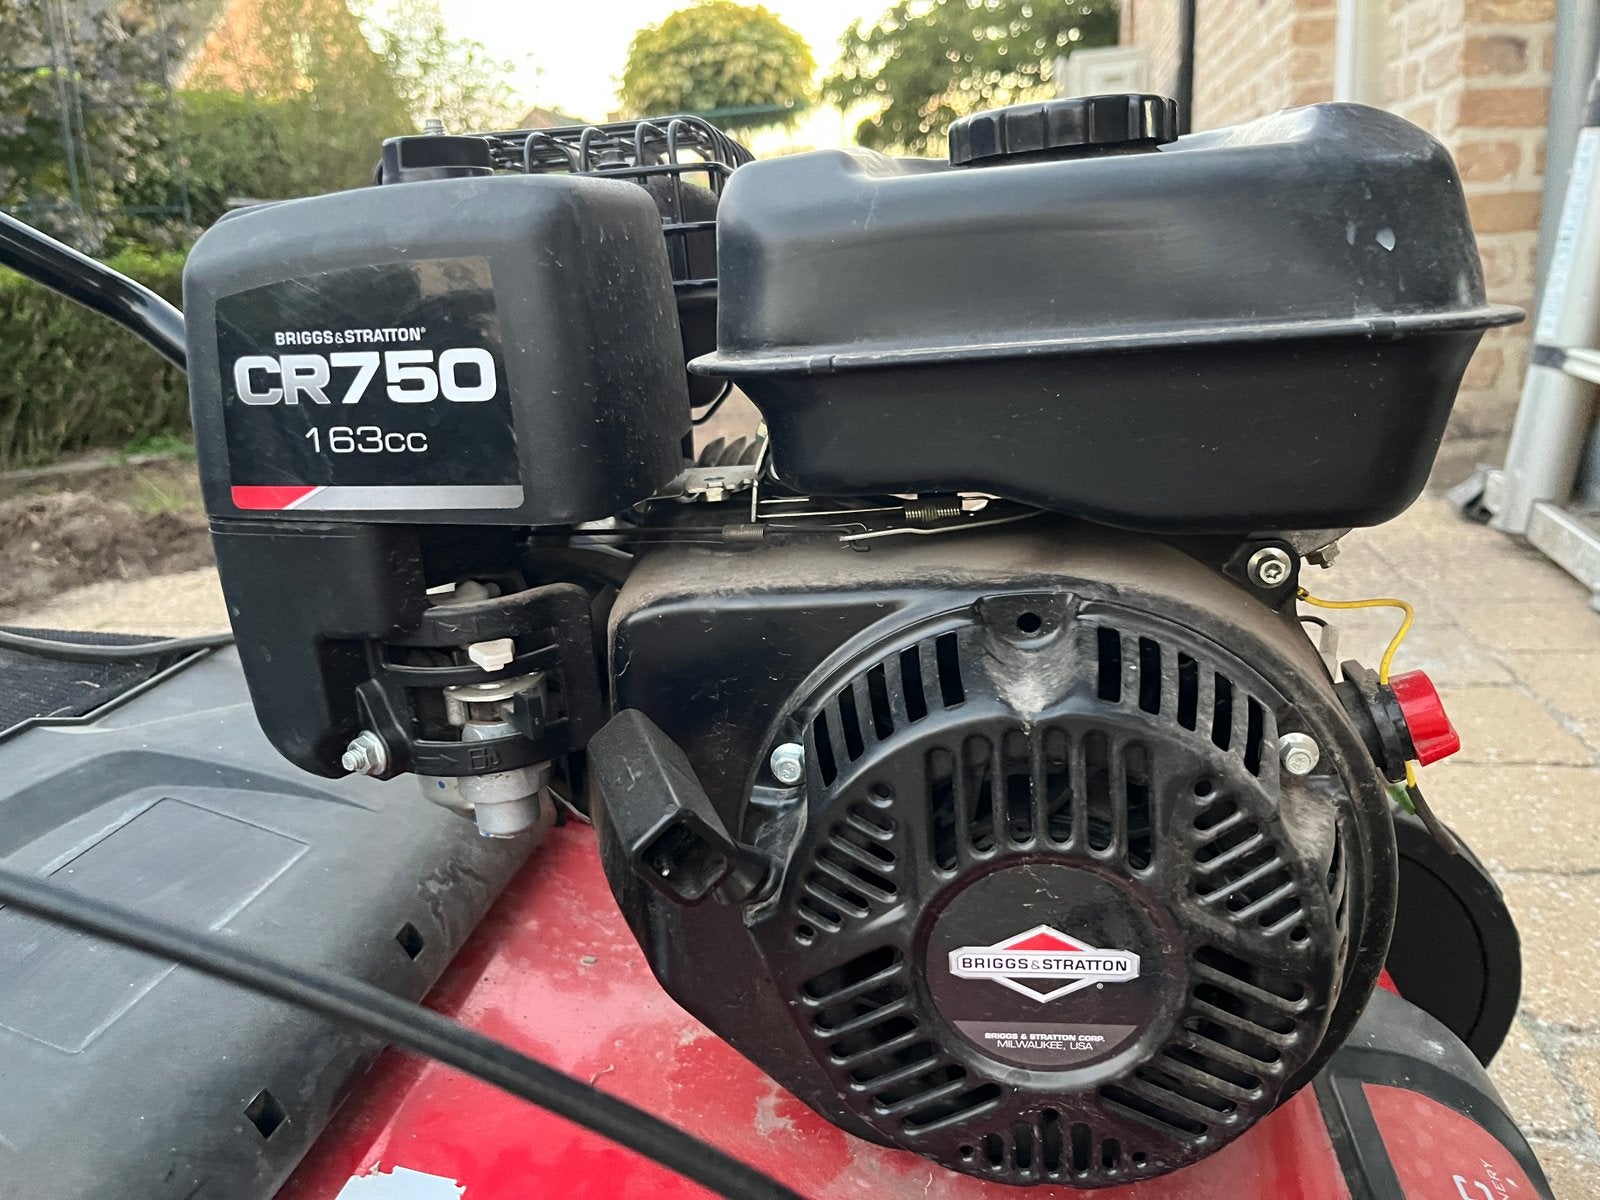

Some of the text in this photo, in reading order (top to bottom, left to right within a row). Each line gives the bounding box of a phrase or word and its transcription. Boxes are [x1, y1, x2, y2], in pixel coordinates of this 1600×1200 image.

[233, 347, 497, 405] CR750
[305, 426, 428, 453] 163cc
[984, 1032, 1018, 1040] BRIGGS
[1029, 1033, 1076, 1041] STRATTON
[997, 1040, 1093, 1051] MILWAUKEE, USA
